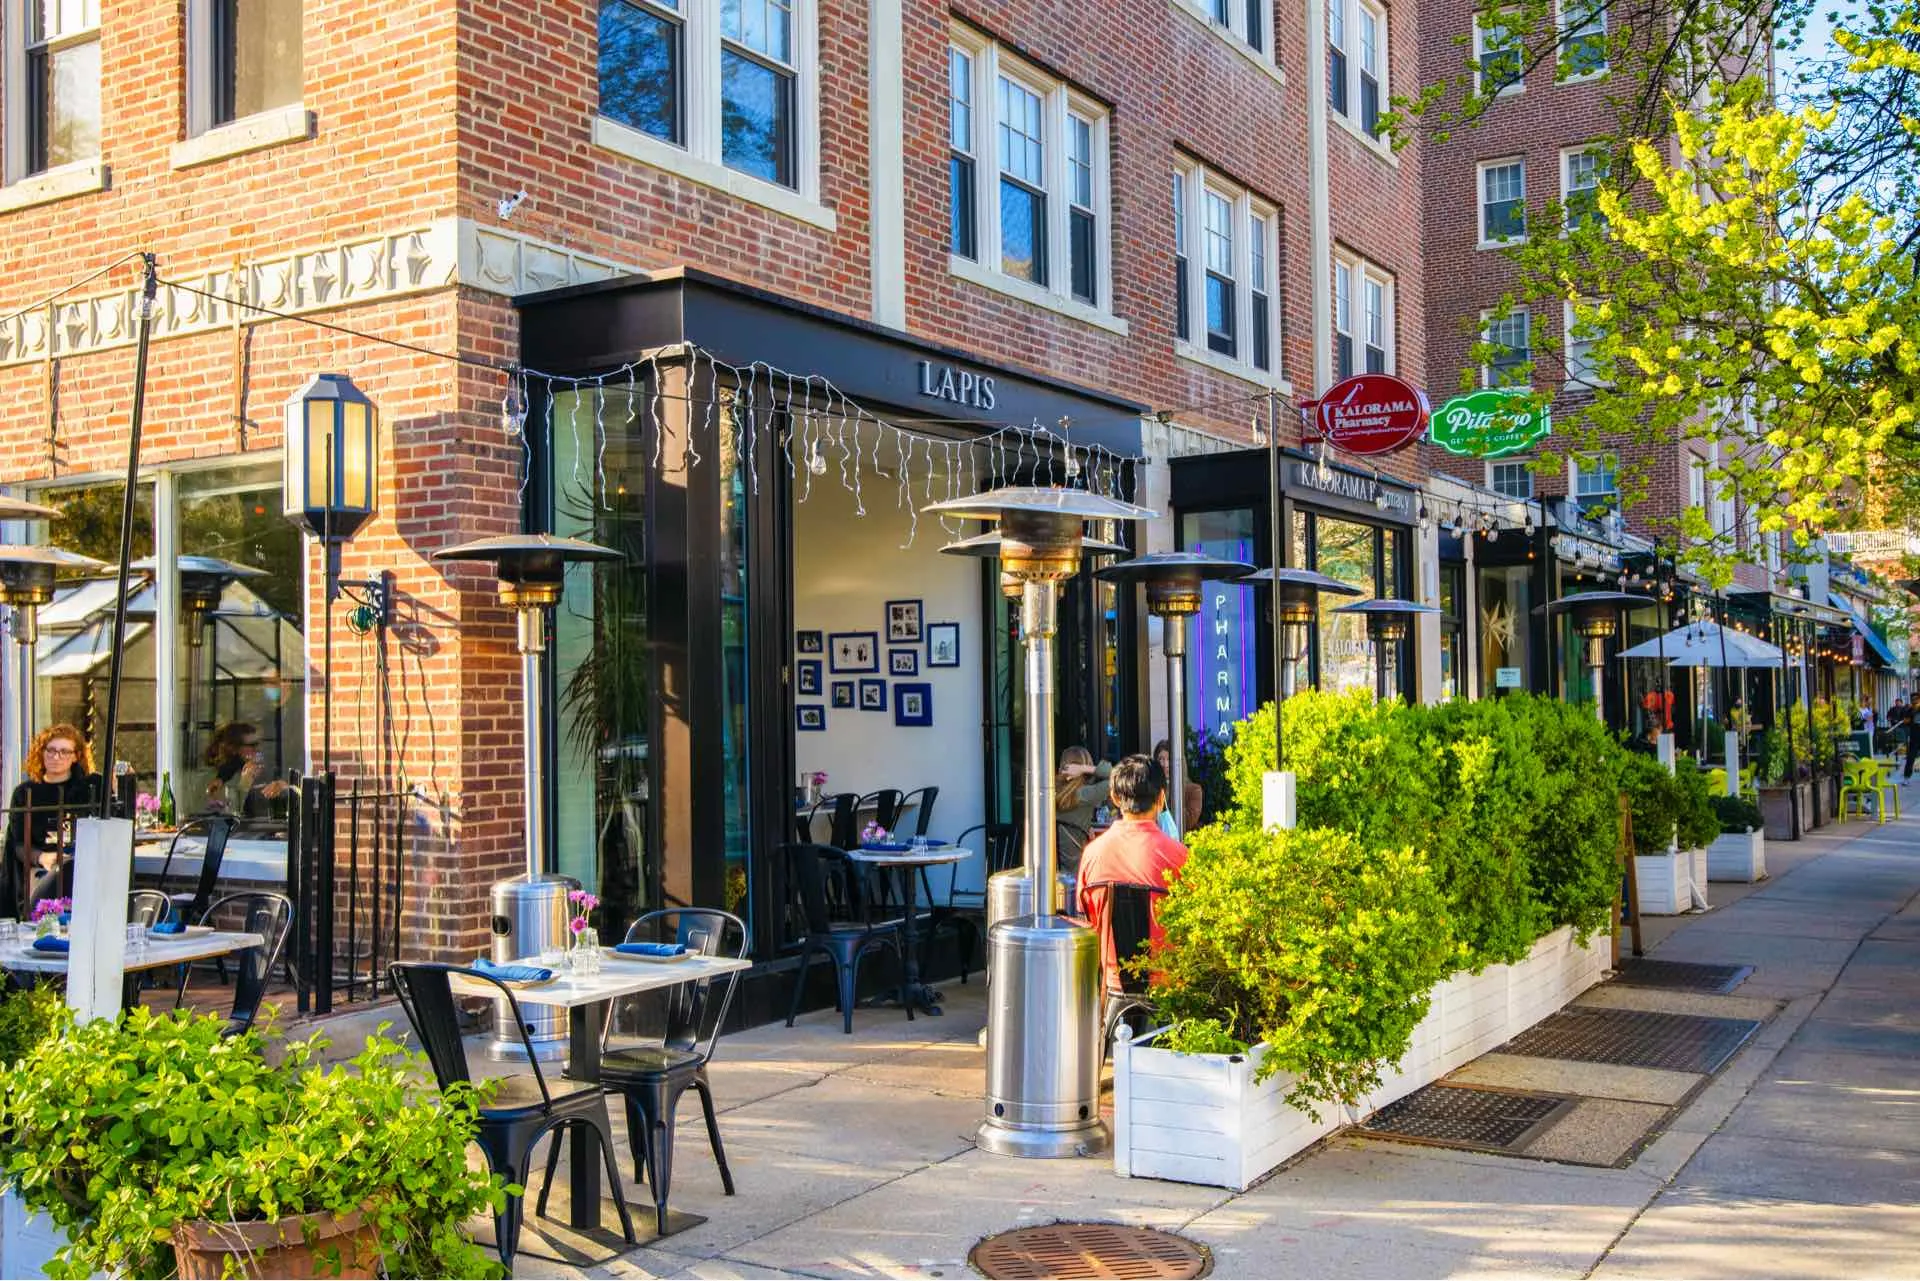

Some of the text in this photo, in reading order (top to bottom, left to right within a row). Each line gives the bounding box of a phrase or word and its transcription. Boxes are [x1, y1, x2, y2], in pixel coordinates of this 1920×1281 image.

[923, 360, 995, 410] LAPIS
[1334, 400, 1414, 417] KALORAMA
[1334, 415, 1391, 429] Pharmacy
[1447, 407, 1531, 433] Pitago
